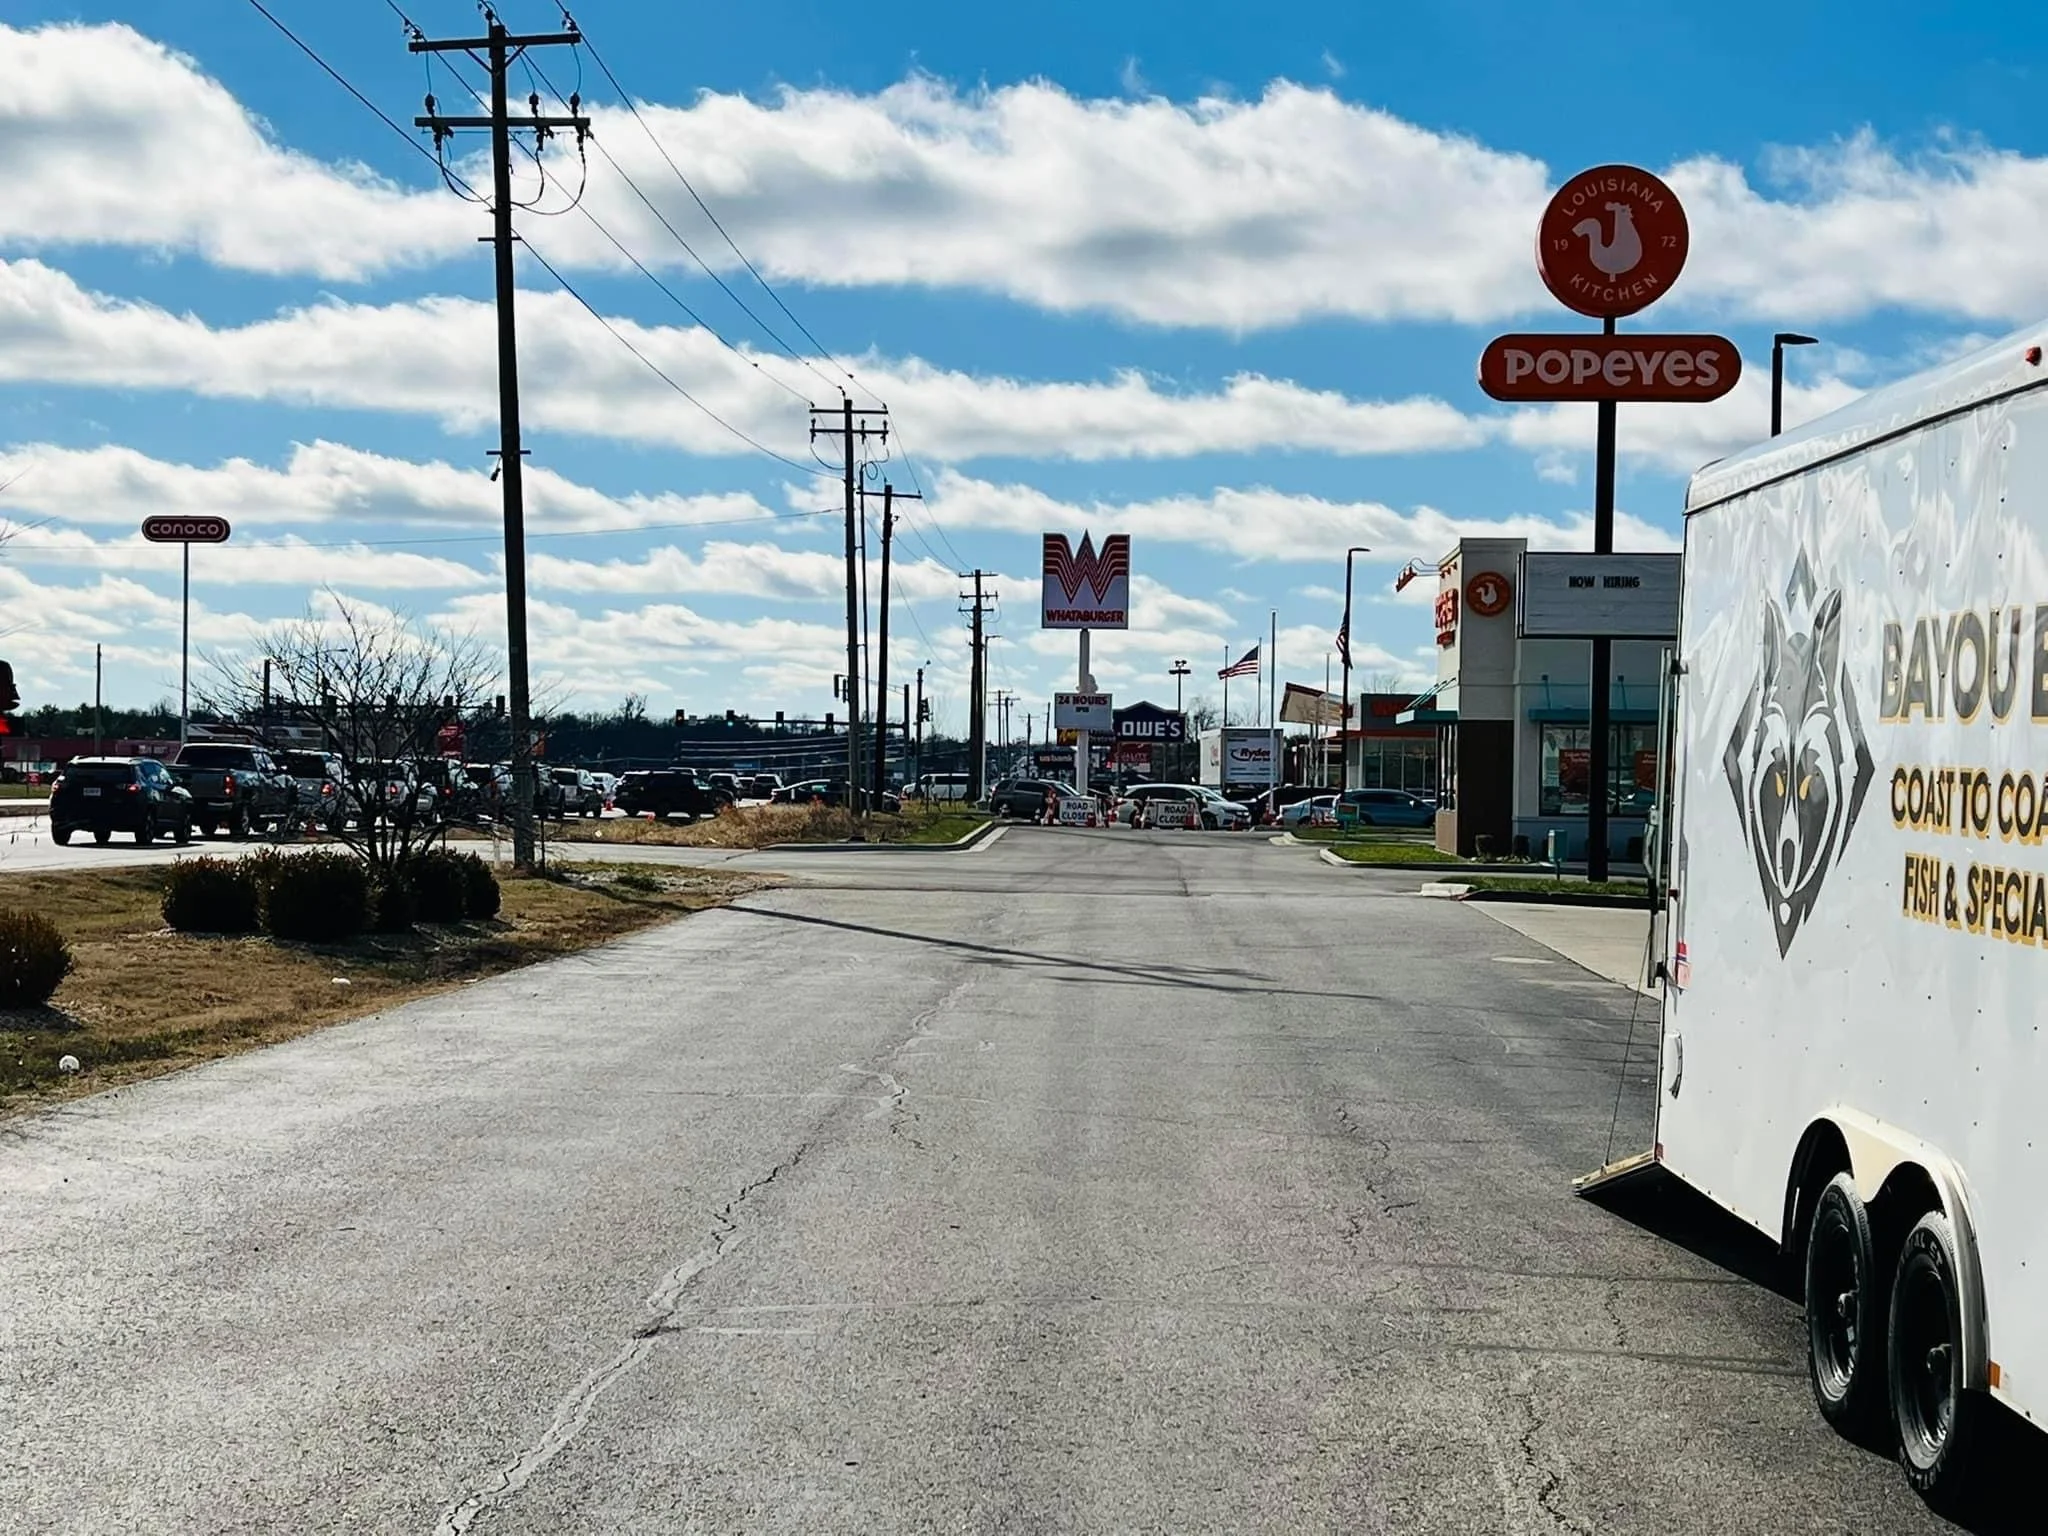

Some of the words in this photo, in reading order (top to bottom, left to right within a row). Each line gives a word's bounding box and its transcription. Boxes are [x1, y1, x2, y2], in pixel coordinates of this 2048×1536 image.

[1562, 178, 1665, 217] LOUISIANA
[1553, 239, 1569, 251] 19
[1661, 235, 1677, 248] 72
[1570, 272, 1659, 302] KITCHEN
[1568, 575, 1596, 588] NOW
[1603, 575, 1641, 589] HIRING
[1046, 610, 1125, 623] WHATABURGER
[1879, 606, 2022, 725] BAYOU
[1058, 695, 1070, 705] 24
[1072, 695, 1108, 706] HOURS
[1117, 719, 1182, 737] OWE'S
[1066, 801, 1089, 810] ROAD
[1164, 805, 1188, 814] ROAD
[1891, 764, 1955, 836] COAST
[1959, 768, 1992, 840] TO
[1062, 811, 1088, 820] CLOSE
[1159, 815, 1186, 824] CLOSE
[1903, 852, 1940, 920] FISH
[1943, 862, 1962, 931] &
